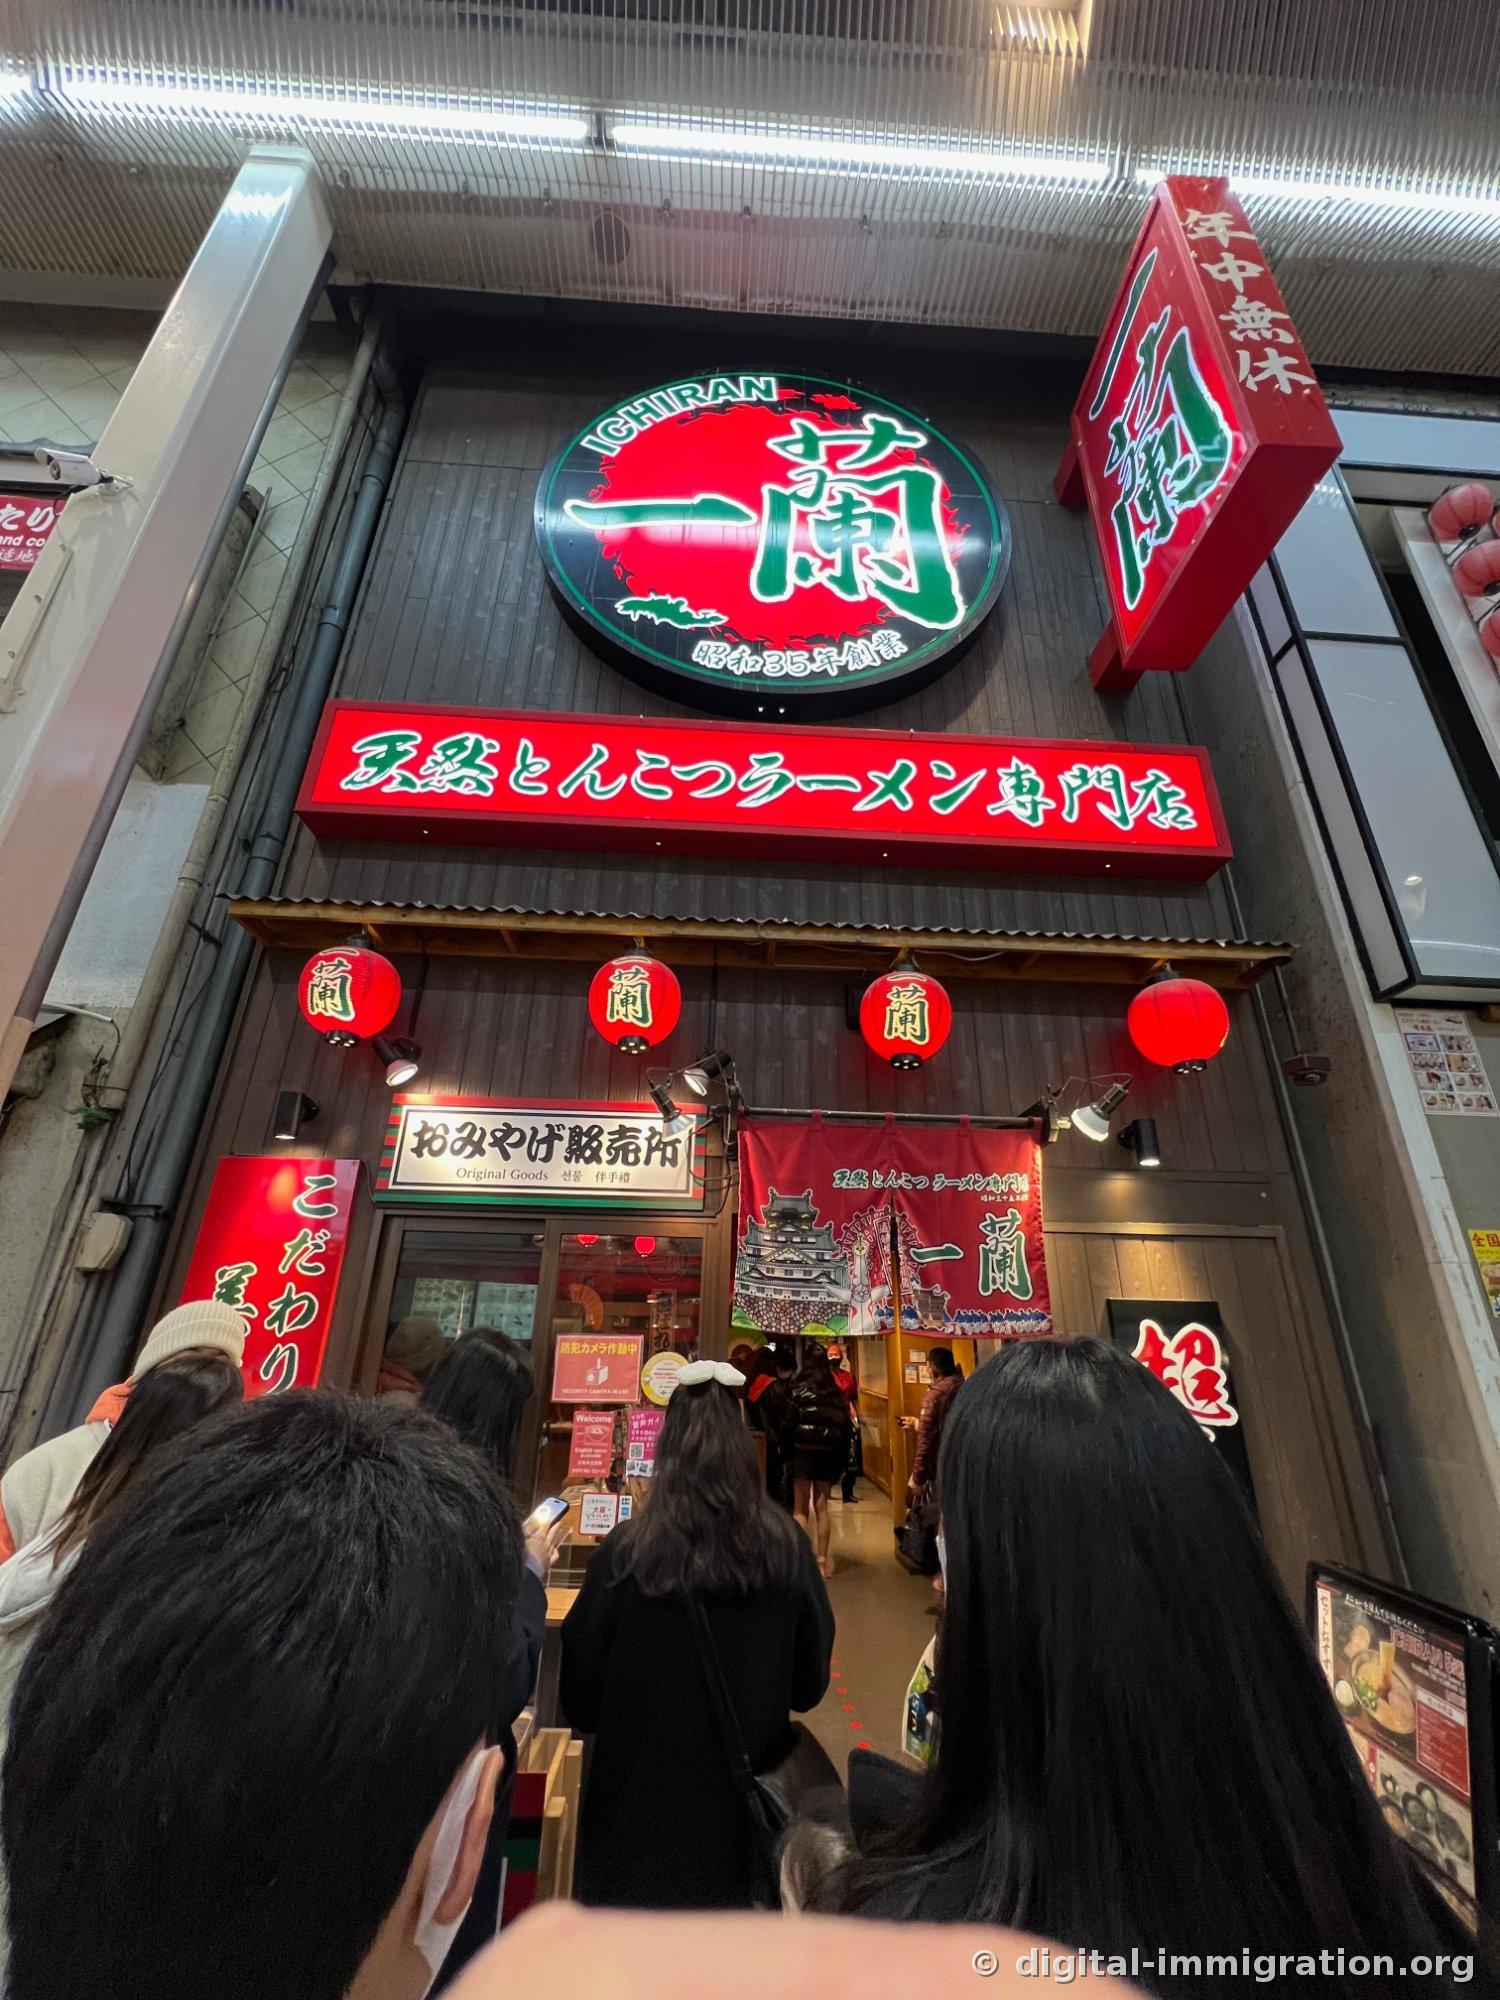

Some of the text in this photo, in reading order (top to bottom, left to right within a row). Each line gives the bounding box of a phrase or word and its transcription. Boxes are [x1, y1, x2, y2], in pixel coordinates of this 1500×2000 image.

[1184, 209, 1316, 394] 年中無休
[580, 376, 779, 457] ICHIRAN
[1089, 246, 1233, 611] 一蘭
[563, 414, 965, 630] 一蘭
[692, 632, 907, 678] 昭和35年創業
[340, 729, 1198, 831] 天然とんこつラーメン専門店
[308, 946, 356, 1022] 一蘭
[606, 955, 653, 1028] 一蘭
[884, 972, 930, 1045] 一蘭
[410, 1119, 682, 1168] おみやげ販売所
[456, 1166, 506, 1181] Original
[510, 1168, 549, 1181] Goods
[260, 1174, 339, 1395] こだわり
[910, 1207, 1034, 1300] 一蘭
[576, 1414, 612, 1423] Welcome
[1131, 1319, 1239, 1443] 超
